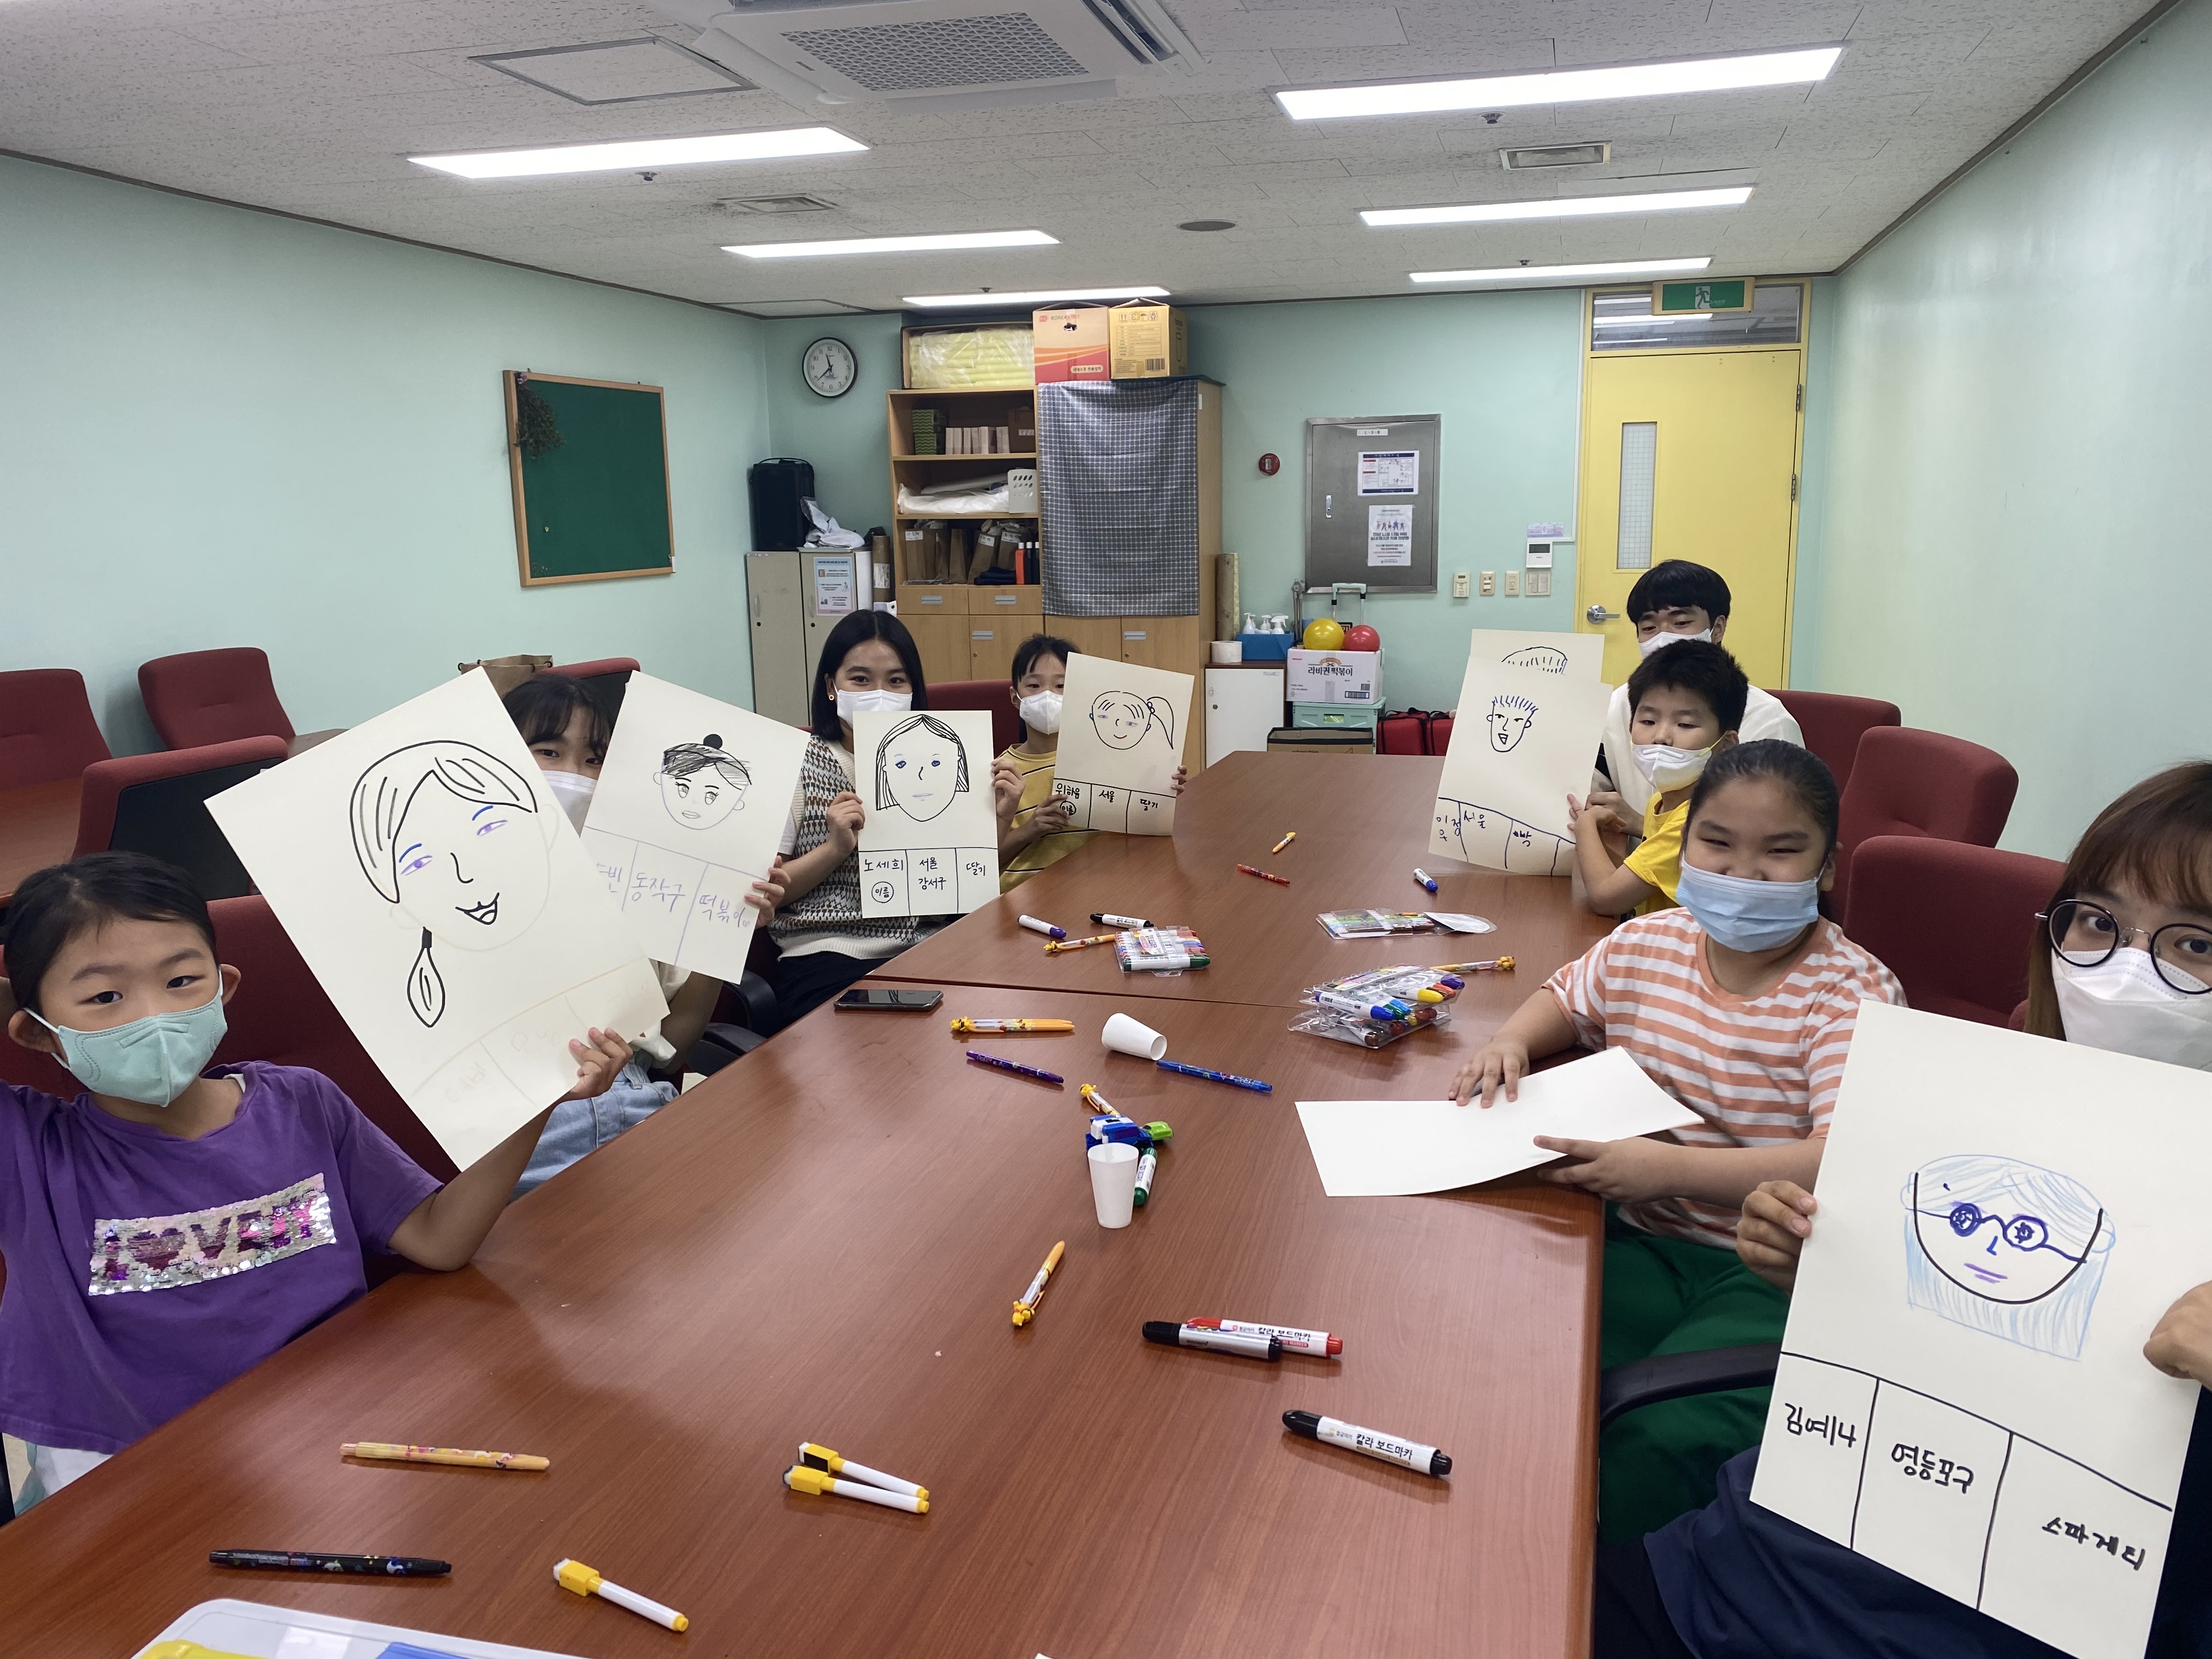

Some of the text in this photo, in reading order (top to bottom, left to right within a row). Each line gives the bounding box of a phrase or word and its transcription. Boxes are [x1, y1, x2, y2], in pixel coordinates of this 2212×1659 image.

[1308, 666, 1353, 676] 라비퀸 떡볶이
[1098, 790, 1115, 803] 서울
[1139, 798, 1158, 811] 딸기
[864, 859, 904, 872] 노세희
[919, 857, 938, 872] 서울
[966, 861, 986, 877] 딸기
[918, 877, 947, 890] 강서구
[631, 872, 686, 913] 동작구
[875, 887, 890, 898] 이름
[1276, 1329, 1311, 1342] 보드마카
[1784, 1402, 1858, 1449] 김예나
[1356, 1433, 1374, 1449] 칼라
[1375, 1440, 1413, 1460] 보드마카
[1891, 1442, 1976, 1494] 영등포구
